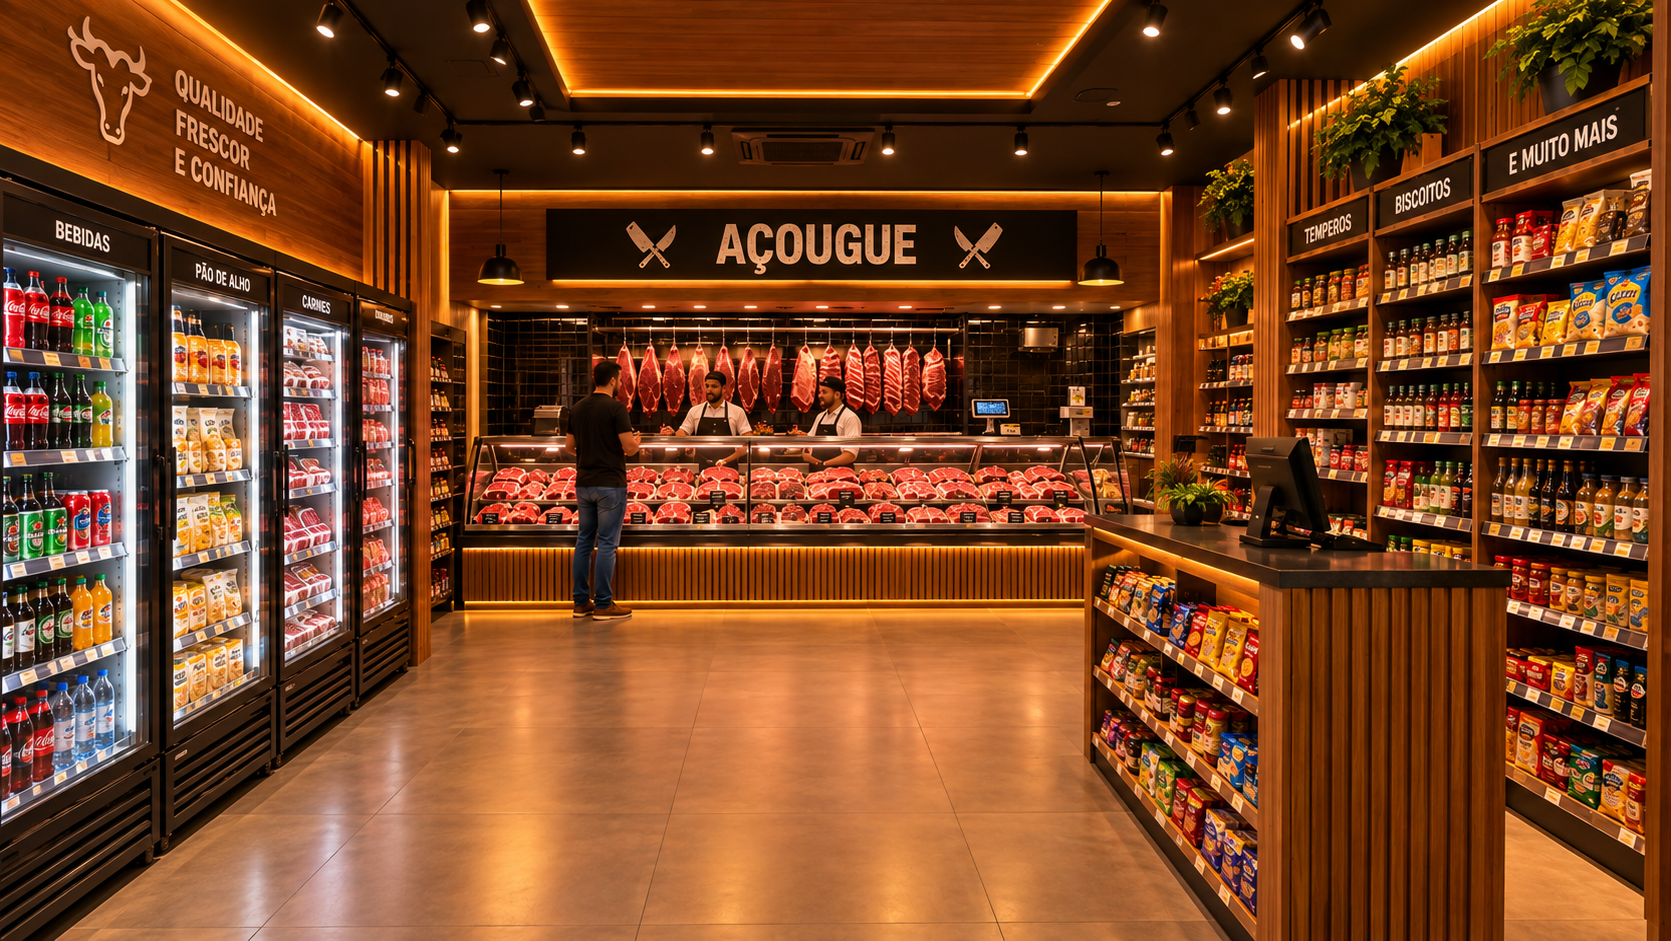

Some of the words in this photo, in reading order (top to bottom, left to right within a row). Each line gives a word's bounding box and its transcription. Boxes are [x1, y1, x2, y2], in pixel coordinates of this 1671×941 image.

[175, 69, 264, 143] QUALIDADE
[175, 108, 251, 171] FRESCOR
[1509, 151, 1518, 175] E
[1521, 132, 1570, 171] MUITO
[1574, 114, 1618, 152] MAIS
[175, 147, 186, 176] E
[190, 155, 277, 217] CONFIANÇA
[1394, 177, 1451, 215] BISCOITOS
[55, 220, 110, 253] BEBIDAS
[715, 222, 917, 276] AÇOUGUE
[1304, 213, 1352, 244] TEMPEROS
[195, 261, 214, 283] PÃO
[216, 269, 227, 287] DE
[228, 273, 251, 292] ALHO
